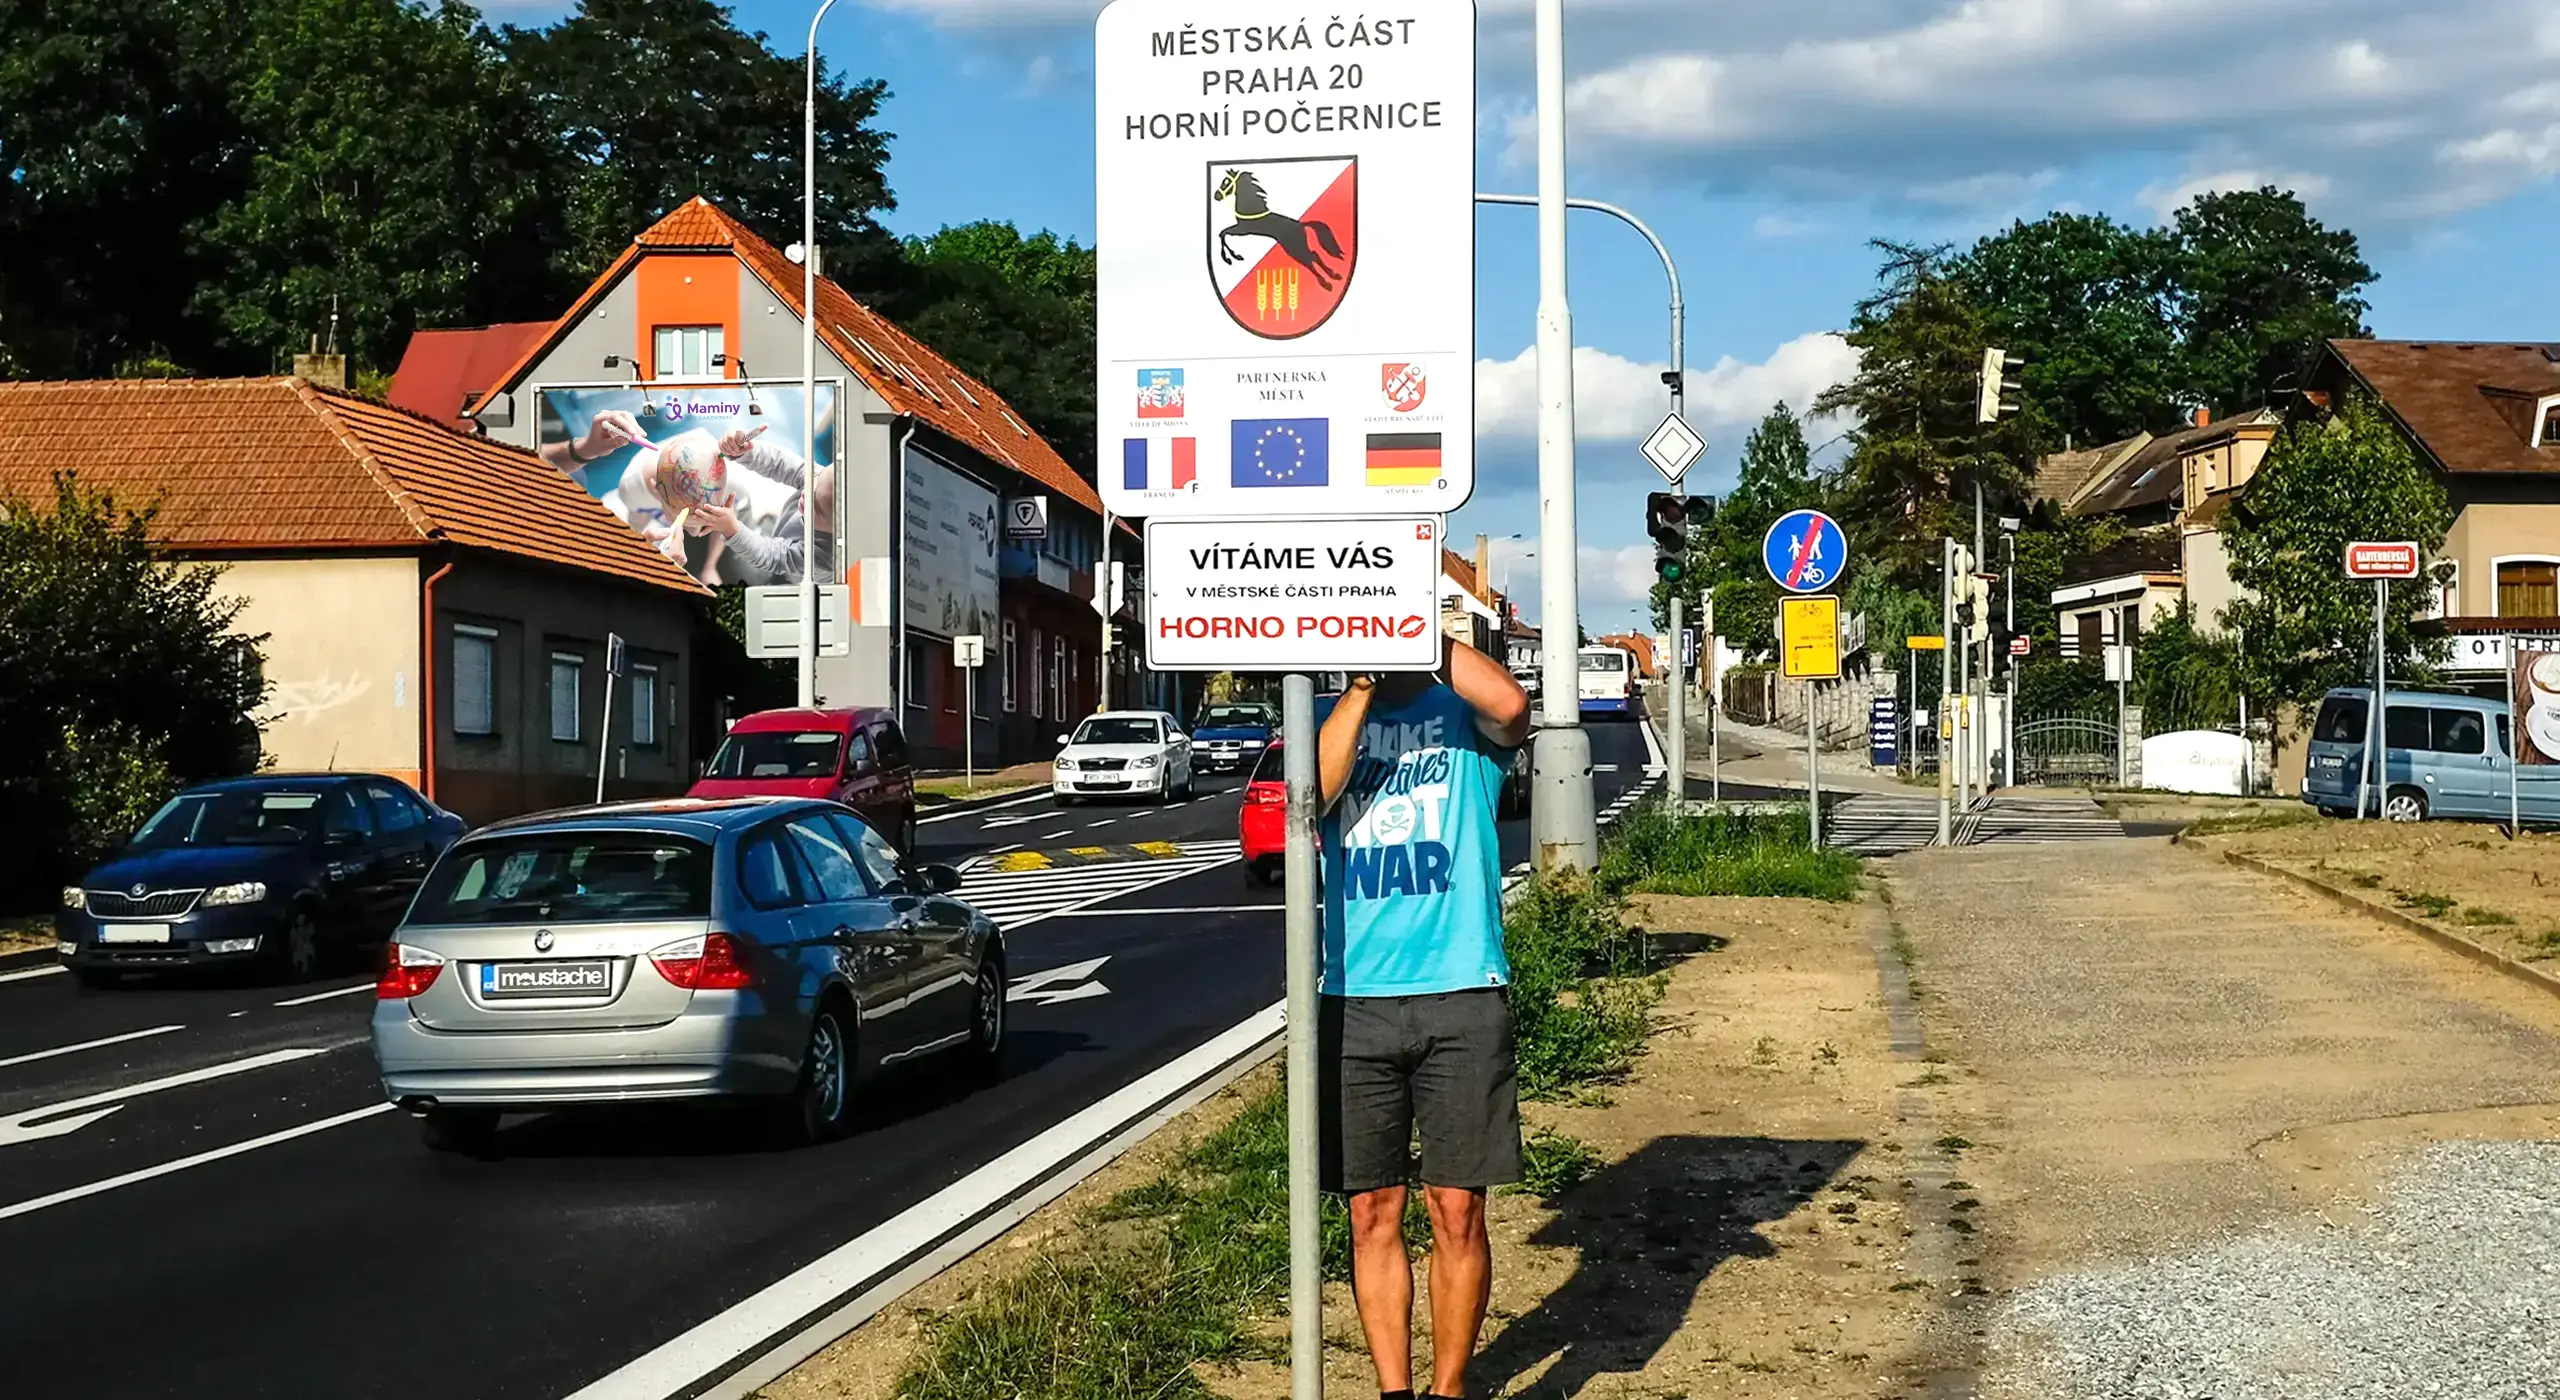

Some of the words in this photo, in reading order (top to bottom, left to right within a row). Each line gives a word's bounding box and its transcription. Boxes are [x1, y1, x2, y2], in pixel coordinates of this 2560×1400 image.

[1152, 17, 1312, 57] MĚSTSKÁ
[1325, 14, 1415, 48] ČÁST
[1202, 66, 1319, 96] PRAHA
[1328, 64, 1363, 90] 20
[1126, 104, 1229, 140] HORNÍ
[1242, 100, 1441, 135] POČERNICE
[1236, 369, 1327, 384] PARTNERSKÁ
[1259, 387, 1305, 402] MĚSTA
[687, 401, 741, 416] Maminy
[1192, 483, 1199, 493] F
[1438, 478, 1448, 490] D
[1189, 542, 1316, 570] VÍTÁME
[1326, 541, 1394, 569] VÁS
[1187, 587, 1197, 598] V
[1202, 584, 1279, 598] MĚSTSKÉ
[1285, 583, 1333, 597] ČÁSTI
[1339, 586, 1397, 597] PRAHA
[1160, 616, 1285, 638] HORNO
[1340, 784, 1449, 848] NOT
[501, 967, 603, 987] moustache
